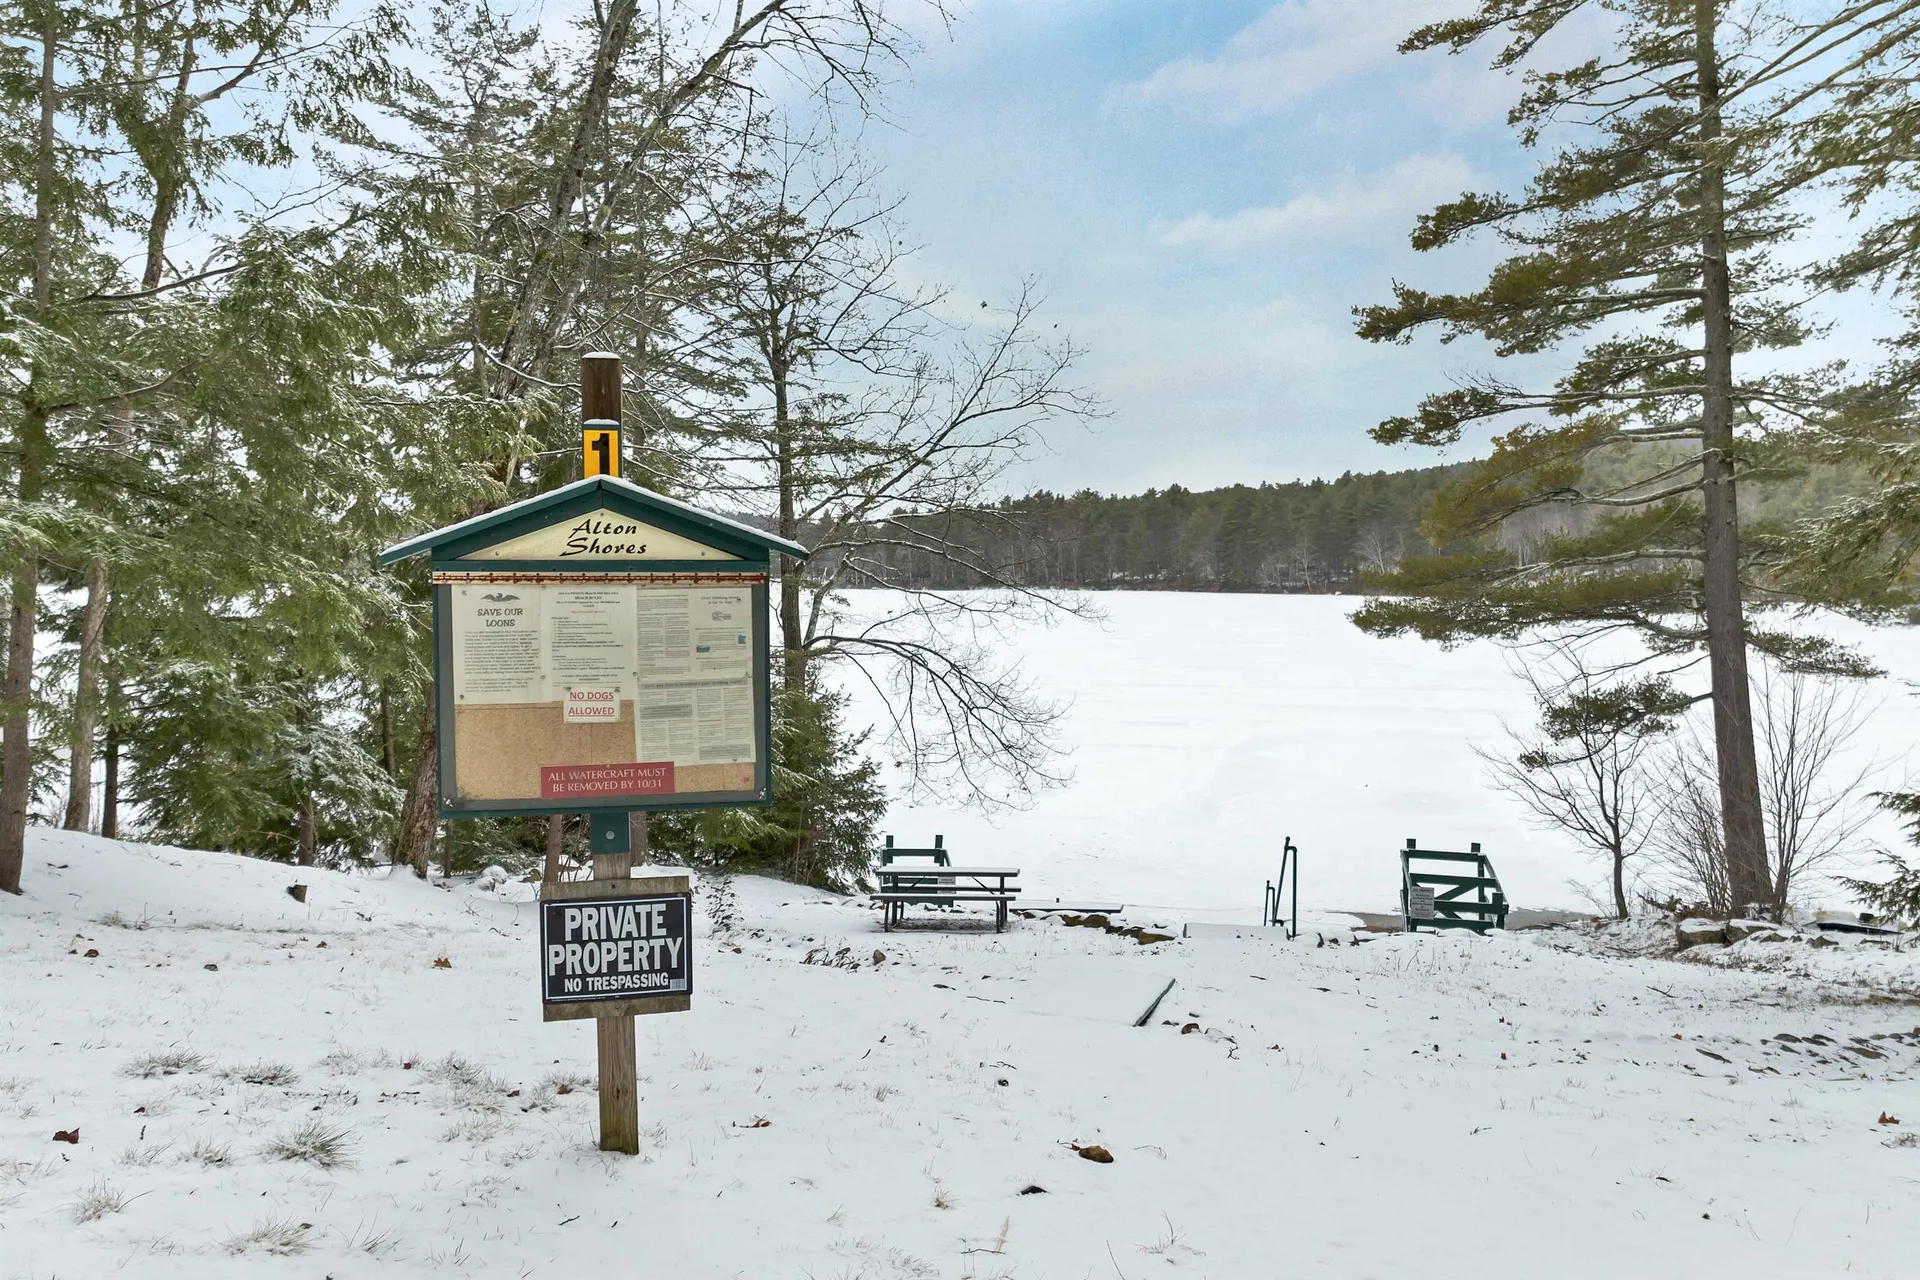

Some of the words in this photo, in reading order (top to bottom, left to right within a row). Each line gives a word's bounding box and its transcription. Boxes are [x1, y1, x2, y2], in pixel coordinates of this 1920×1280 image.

[592, 433, 610, 475] 1
[568, 519, 637, 539] Alton
[559, 537, 647, 557] Shores
[477, 608, 502, 616] SAVE
[504, 608, 524, 616] OUR
[486, 619, 516, 627] LOONS
[570, 691, 585, 700] NO
[587, 691, 614, 700] DOGS
[568, 706, 615, 715] ALLOWED
[548, 772, 567, 781] ALL
[568, 769, 635, 780] WATERCRAFT
[637, 767, 667, 778] MUST
[552, 783, 565, 792] BE
[567, 780, 618, 792] REMOVED
[620, 780, 634, 789] BY
[637, 779, 662, 789] 10/31
[564, 903, 667, 942] PRIVATE
[548, 936, 683, 976] PROPERTY
[564, 977, 582, 992] NO
[586, 972, 669, 991] TRESPASSING
